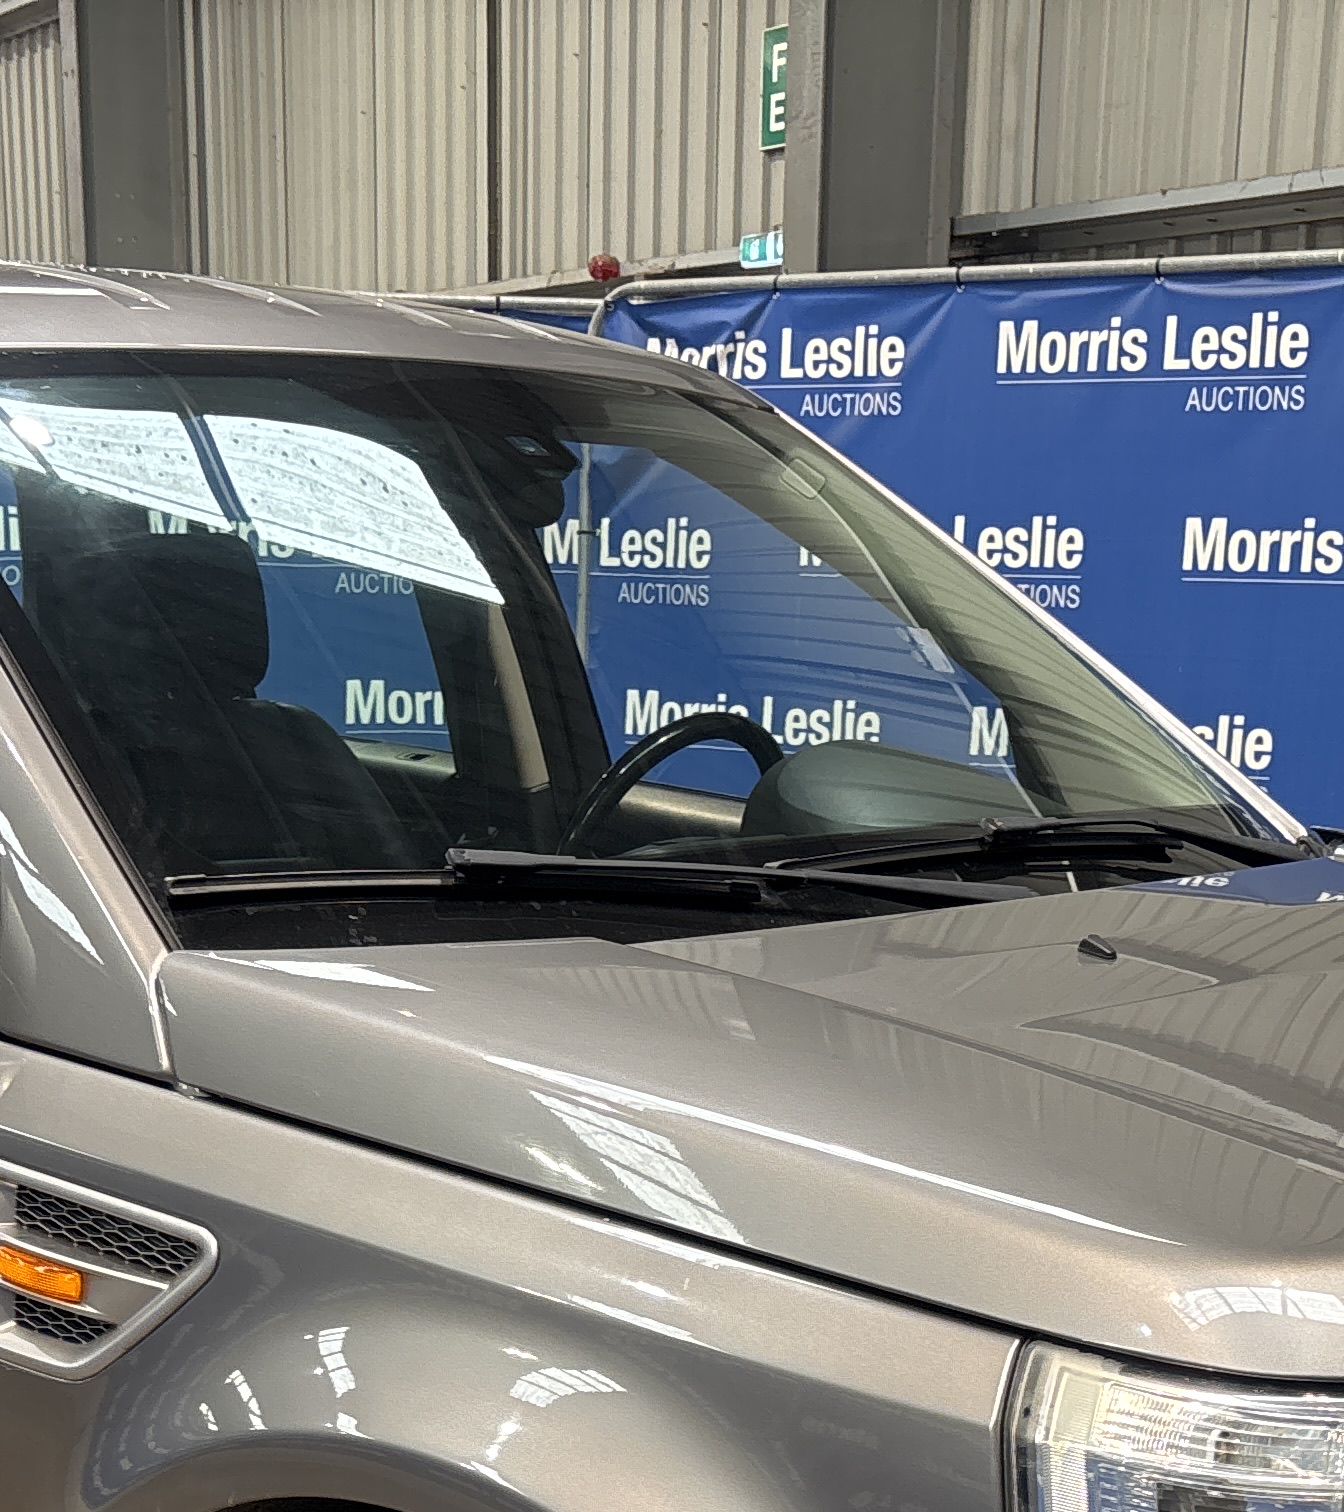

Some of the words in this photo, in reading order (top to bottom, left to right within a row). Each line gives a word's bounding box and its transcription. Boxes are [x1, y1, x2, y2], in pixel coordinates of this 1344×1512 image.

[780, 324, 905, 379] Leslie
[997, 317, 1148, 373] Morris
[1162, 311, 1309, 370] Leslie
[799, 392, 902, 417] AUCTIONS
[1184, 385, 1305, 412] AUCTIONS
[599, 517, 712, 569] Leslie
[1183, 517, 1344, 574] Morris
[617, 582, 710, 607] AUCTIONS
[762, 695, 881, 746] Leslie
